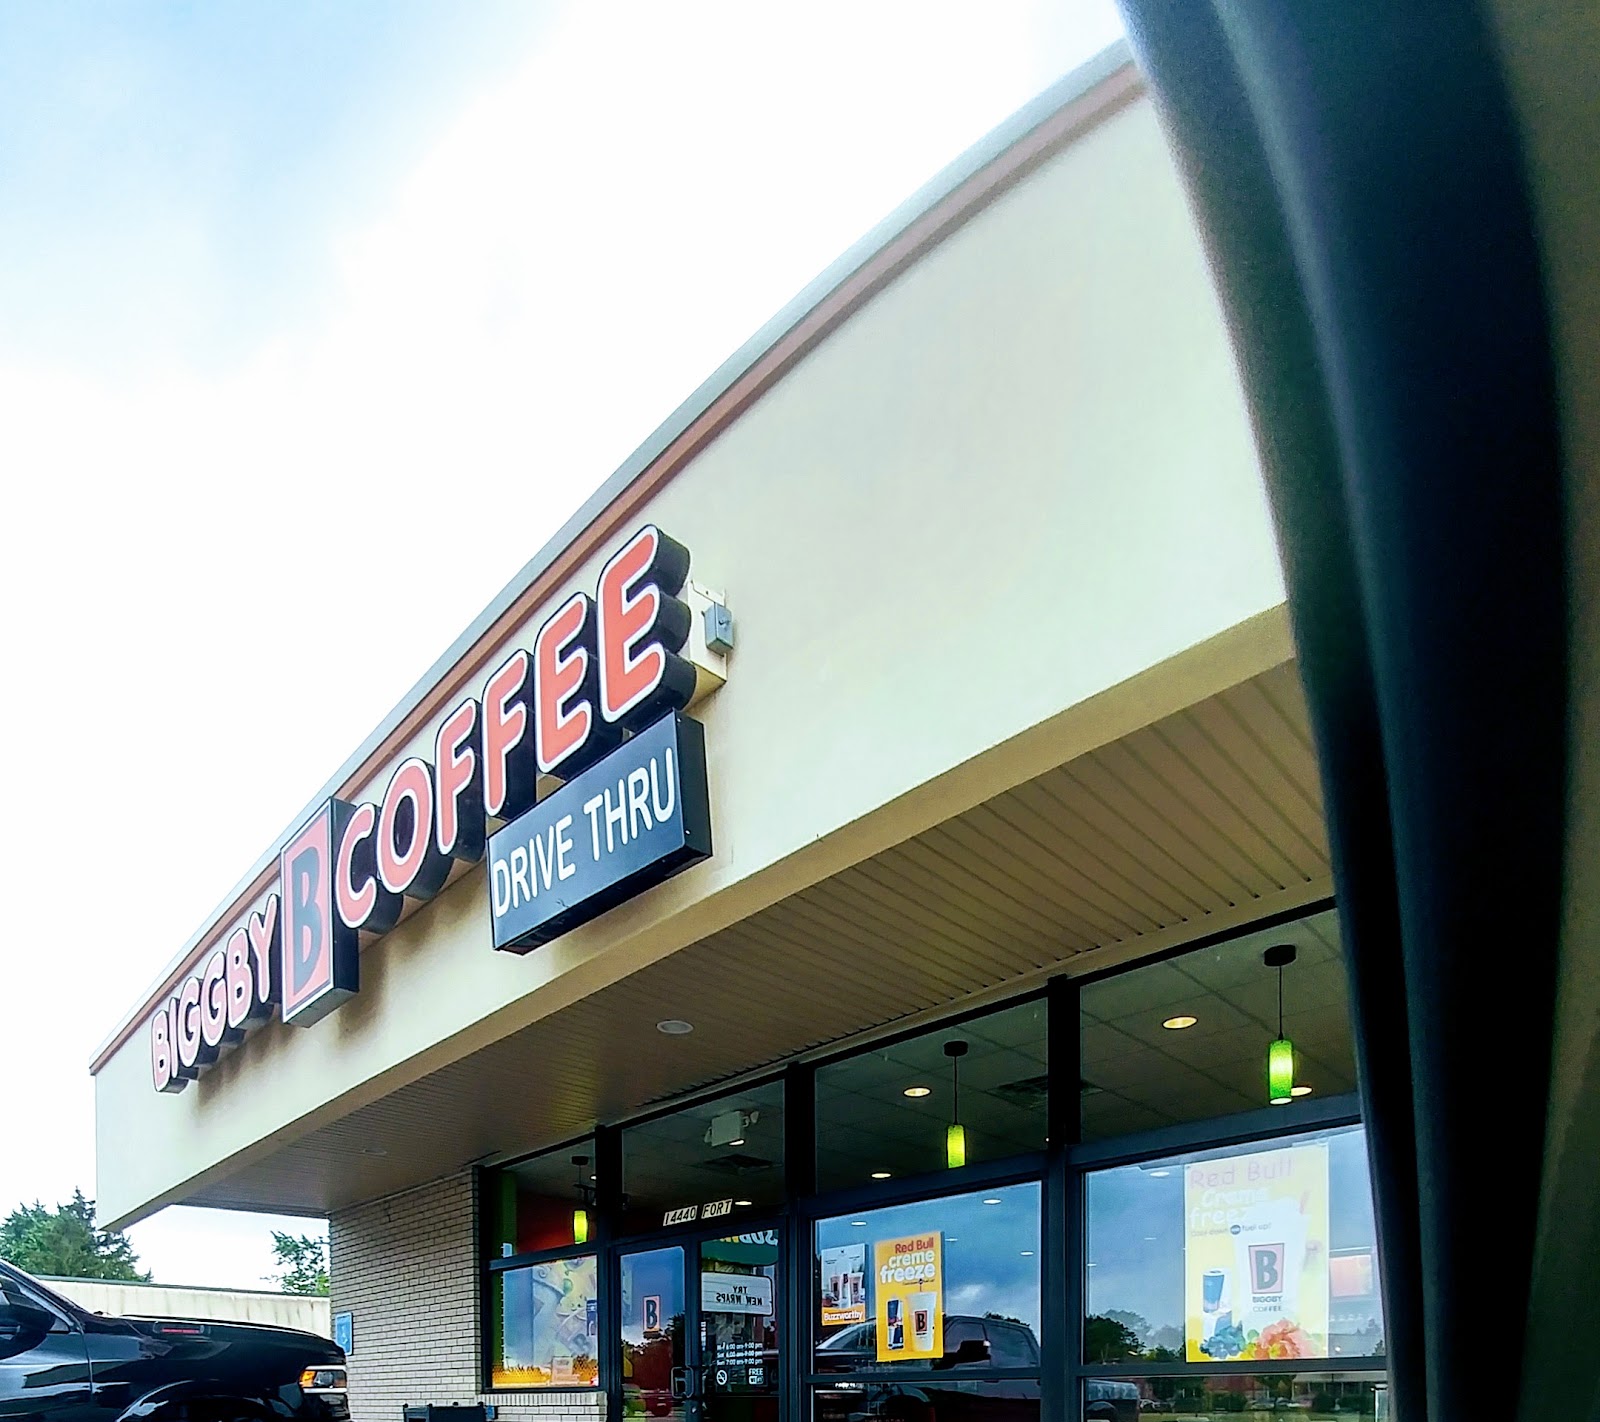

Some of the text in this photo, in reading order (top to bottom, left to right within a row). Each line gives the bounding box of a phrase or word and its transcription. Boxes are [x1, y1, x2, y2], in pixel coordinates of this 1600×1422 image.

[151, 524, 666, 1092] BIGGBY B COFFEE
[492, 747, 675, 918] DRIVE THRU
[1190, 1156, 1291, 1188] Red Bull
[664, 1200, 732, 1225] 14440 FORT
[895, 1237, 934, 1254] Red Bull
[888, 1249, 935, 1269] creme
[1255, 1250, 1278, 1290] B
[879, 1262, 936, 1284] freeze
[1252, 1295, 1283, 1303] BIGGBY
[1252, 1305, 1283, 1313] COFFEE
[645, 1299, 658, 1329] B
[748, 1367, 764, 1376] FREE
